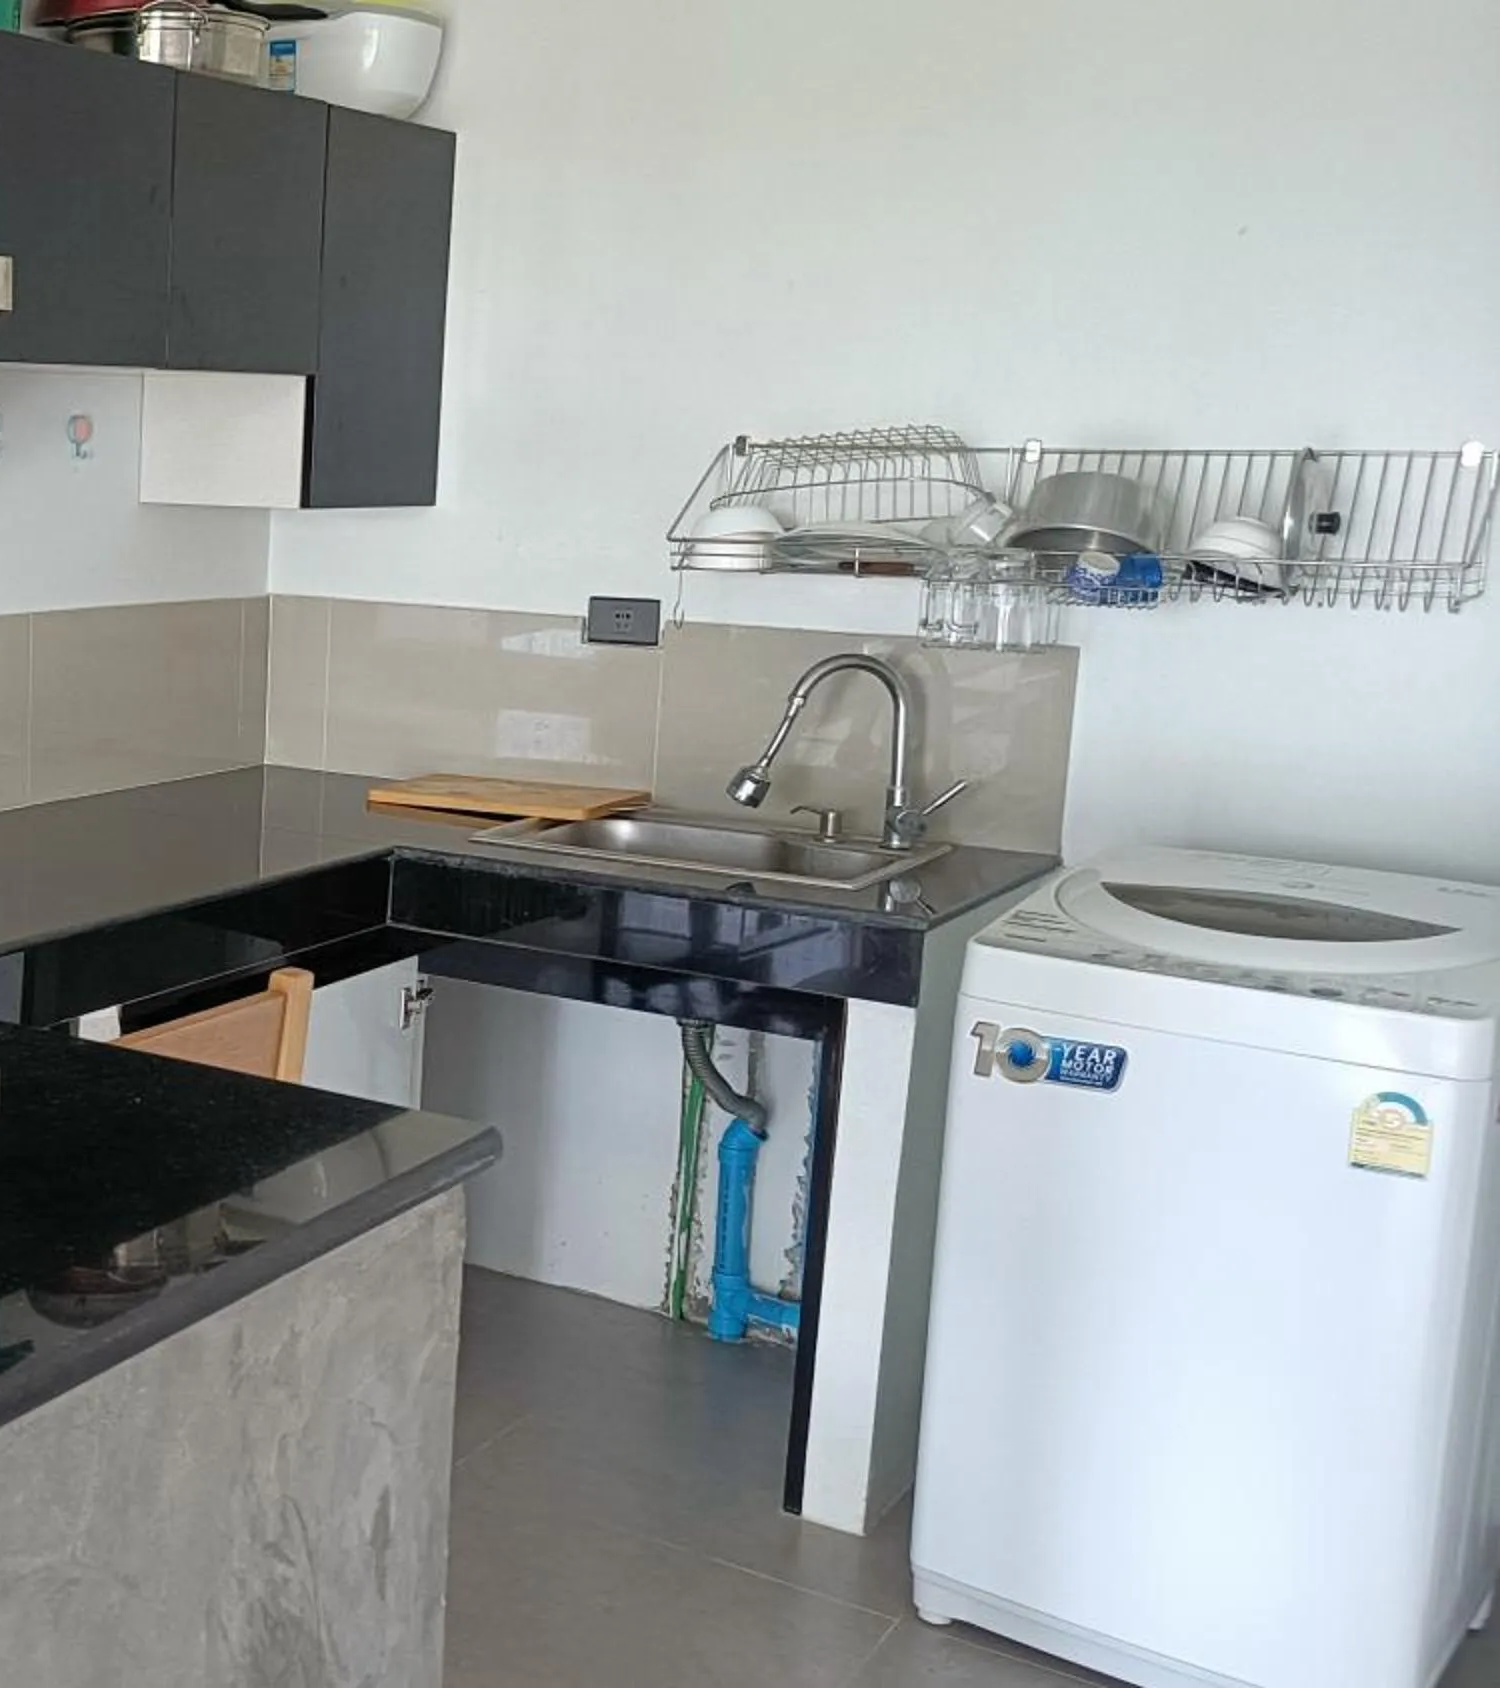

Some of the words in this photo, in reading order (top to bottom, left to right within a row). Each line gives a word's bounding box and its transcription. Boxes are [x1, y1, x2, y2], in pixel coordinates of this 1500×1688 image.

[970, 1020, 1049, 1083] 10
[1060, 1042, 1117, 1065] YEAR
[1060, 1059, 1114, 1075] MOTOR
